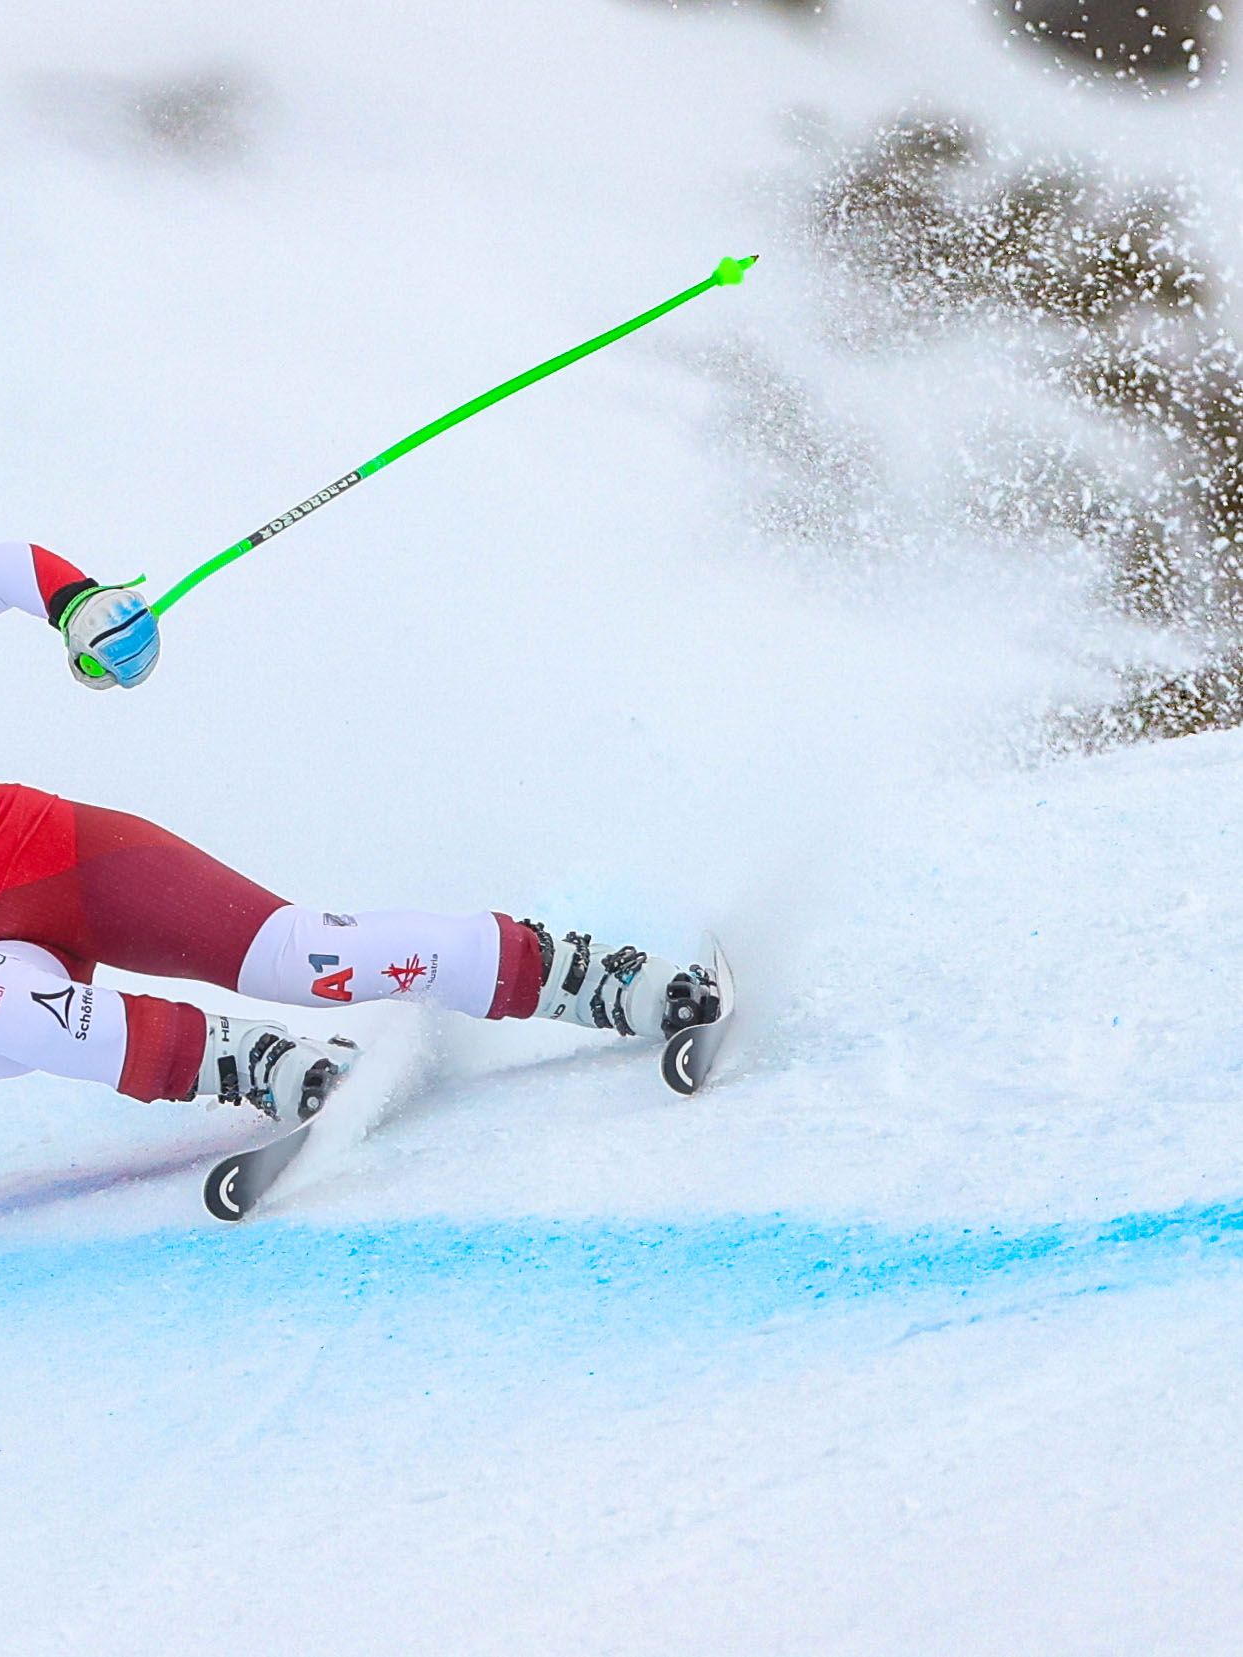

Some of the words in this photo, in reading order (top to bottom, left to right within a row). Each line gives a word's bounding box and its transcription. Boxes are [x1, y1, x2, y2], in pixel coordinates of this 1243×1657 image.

[308, 953, 354, 1002] A1
[75, 986, 94, 1040] Schöffel
[219, 1016, 230, 1042] HEA
